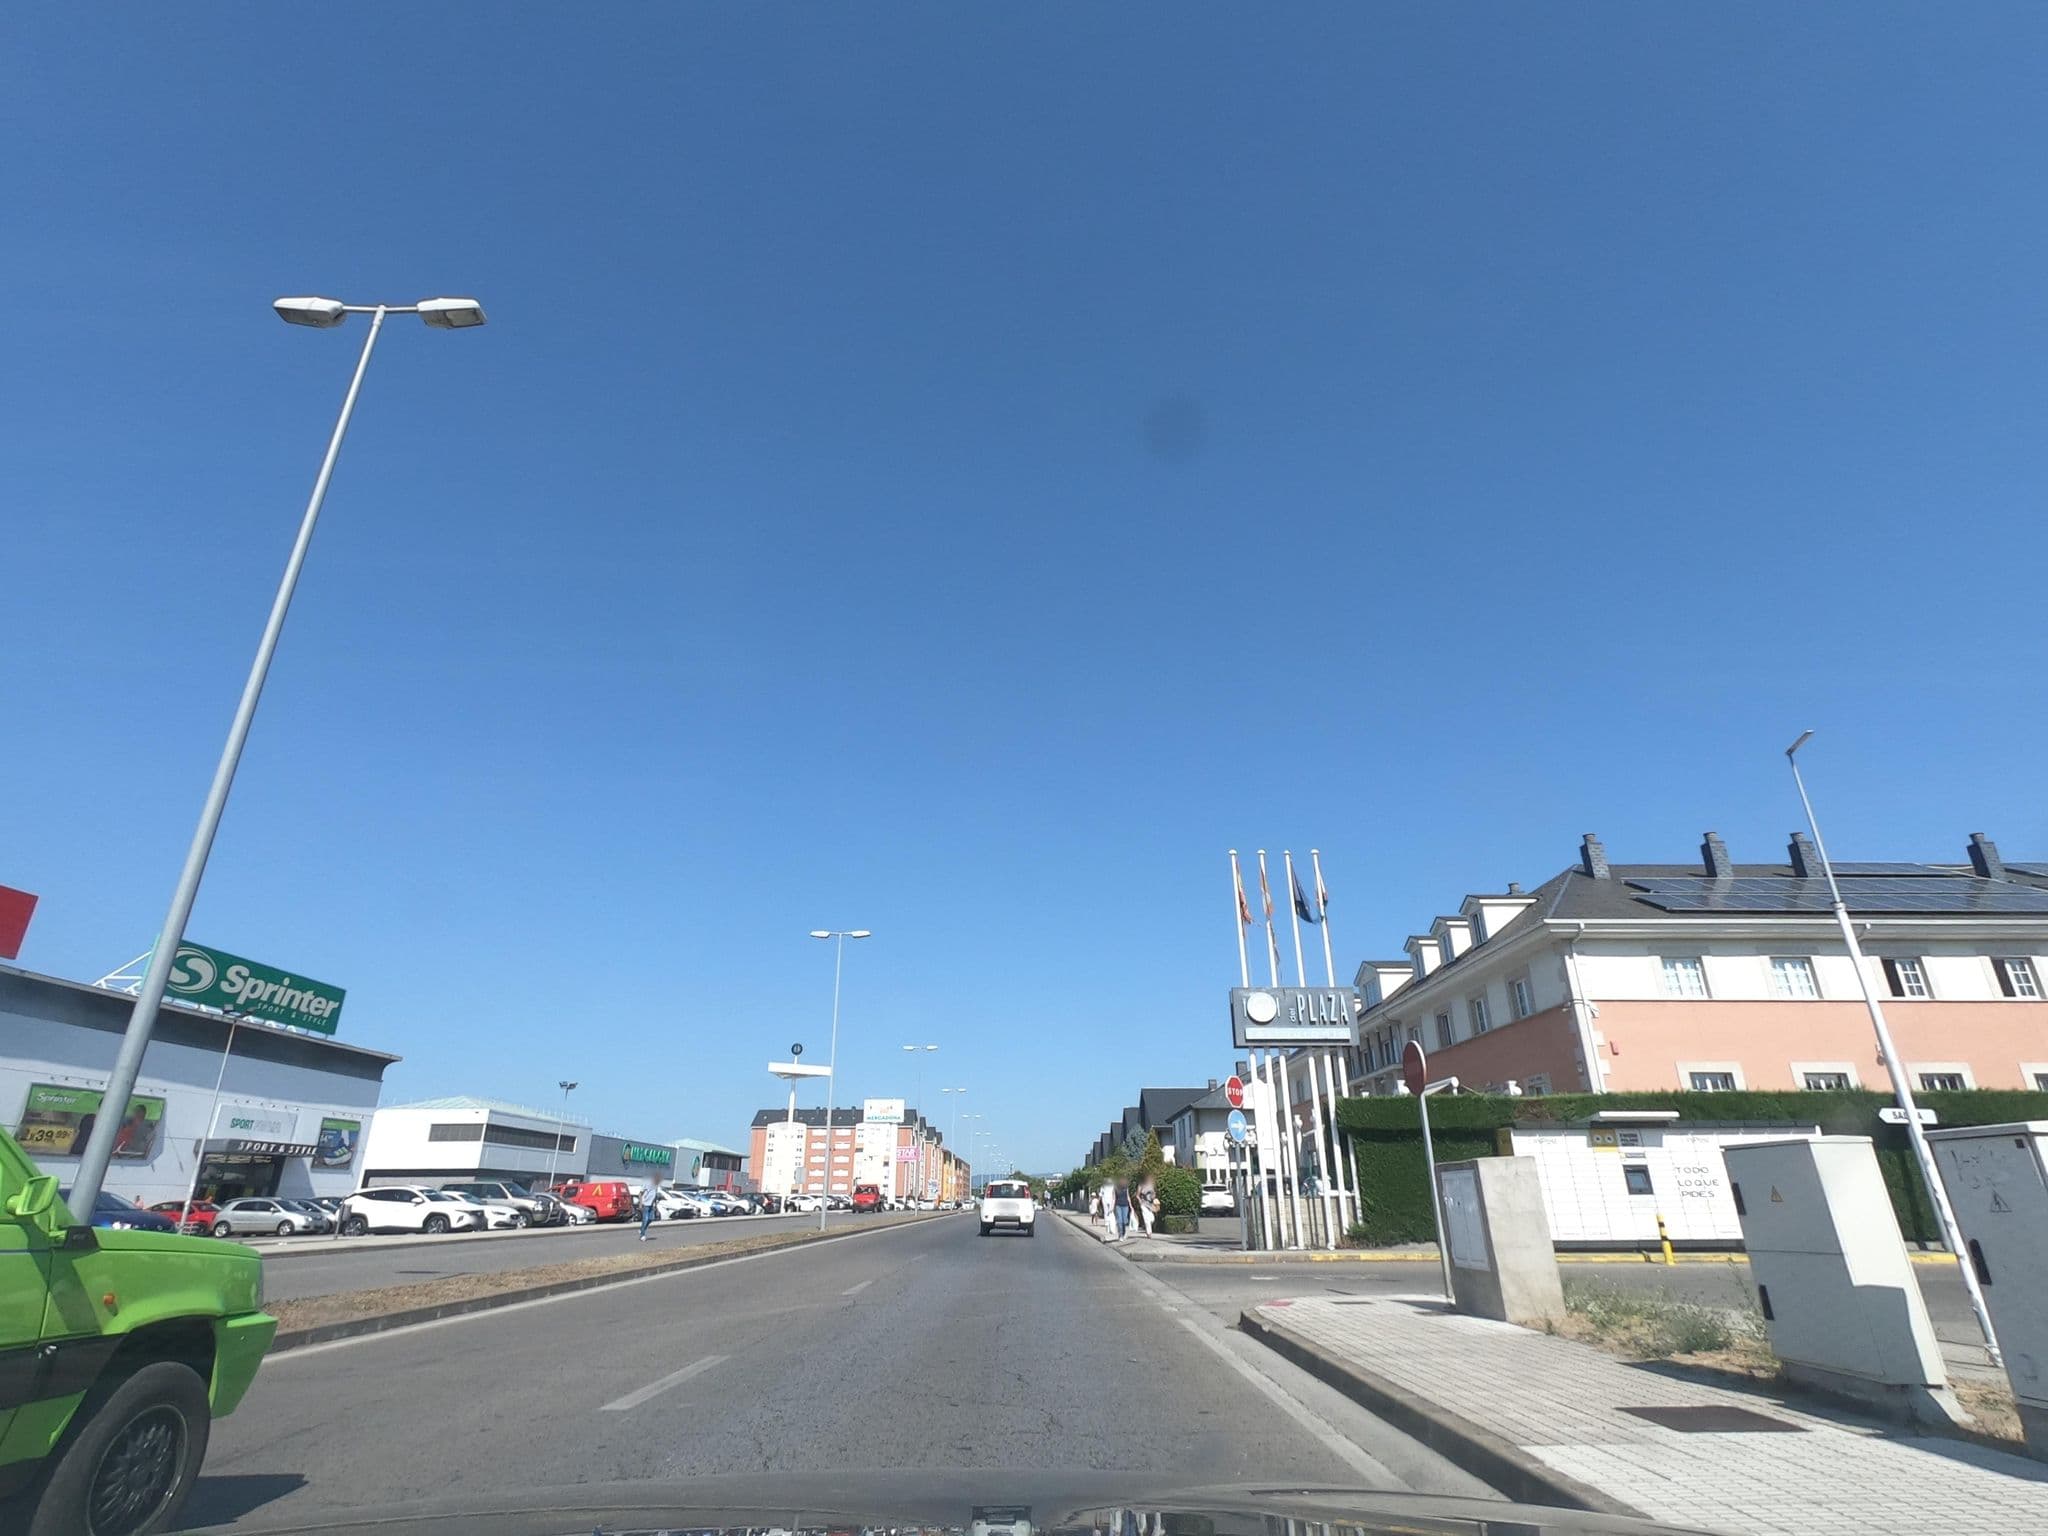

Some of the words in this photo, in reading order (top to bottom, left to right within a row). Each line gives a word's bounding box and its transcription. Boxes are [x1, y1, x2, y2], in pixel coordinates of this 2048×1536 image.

[220, 965, 339, 1018] Sprinter
[257, 1002, 285, 1015] SPORT
[302, 1015, 327, 1026] STYLE
[1297, 993, 1350, 1024] PLAZA
[1228, 1087, 1243, 1096] STOP
[230, 1117, 255, 1130] SPORT
[238, 1142, 277, 1152] SPORT
[288, 1147, 318, 1155] STYLE
